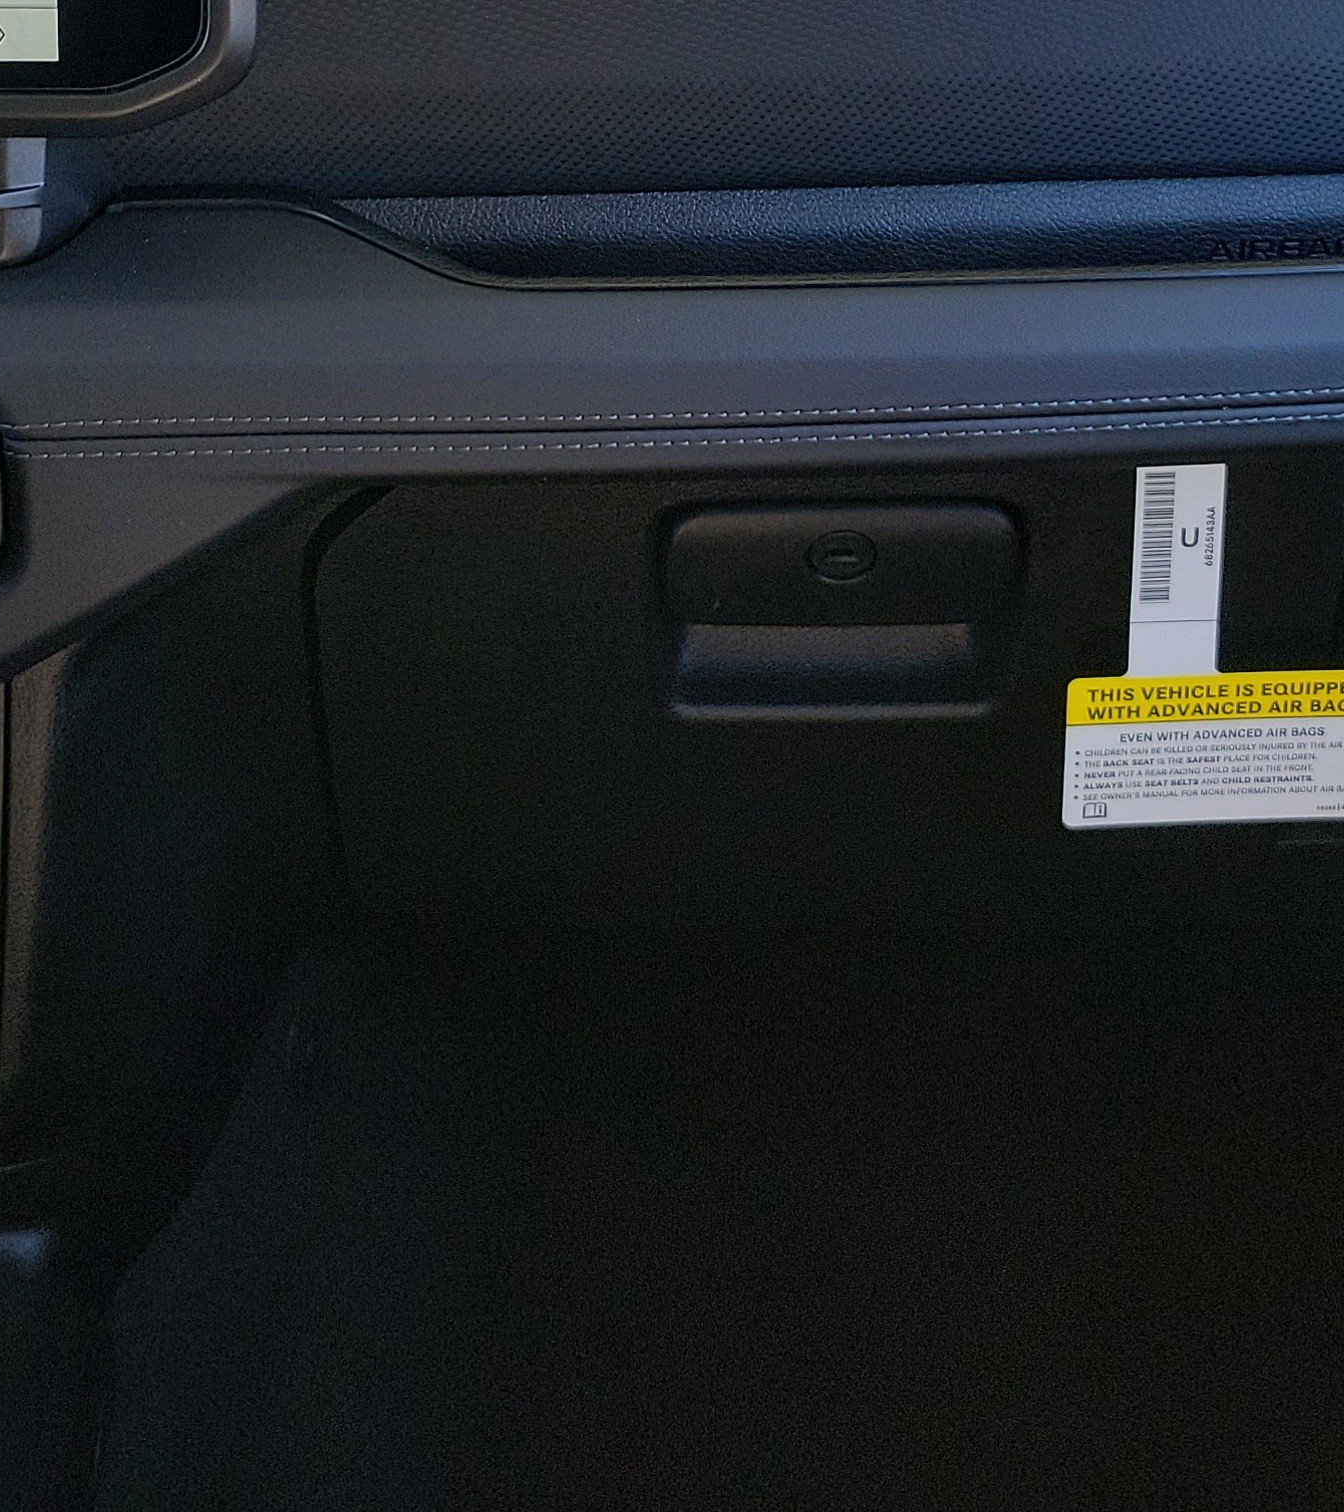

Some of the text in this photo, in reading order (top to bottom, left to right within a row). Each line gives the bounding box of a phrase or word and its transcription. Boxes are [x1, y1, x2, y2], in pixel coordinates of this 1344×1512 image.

[1181, 527, 1199, 547] U
[1087, 688, 1134, 702] THIS
[1141, 685, 1228, 700] VEHICLE
[1236, 683, 1254, 696] IS
[1087, 705, 1140, 720] WITH
[1147, 701, 1262, 718] ADVANCED
[1269, 700, 1302, 713] AIR
[1120, 727, 1325, 742] EVEN WITH ADVANCED AIR BAGS
[1103, 759, 1129, 767] BACK
[1132, 758, 1154, 766] SEAT
